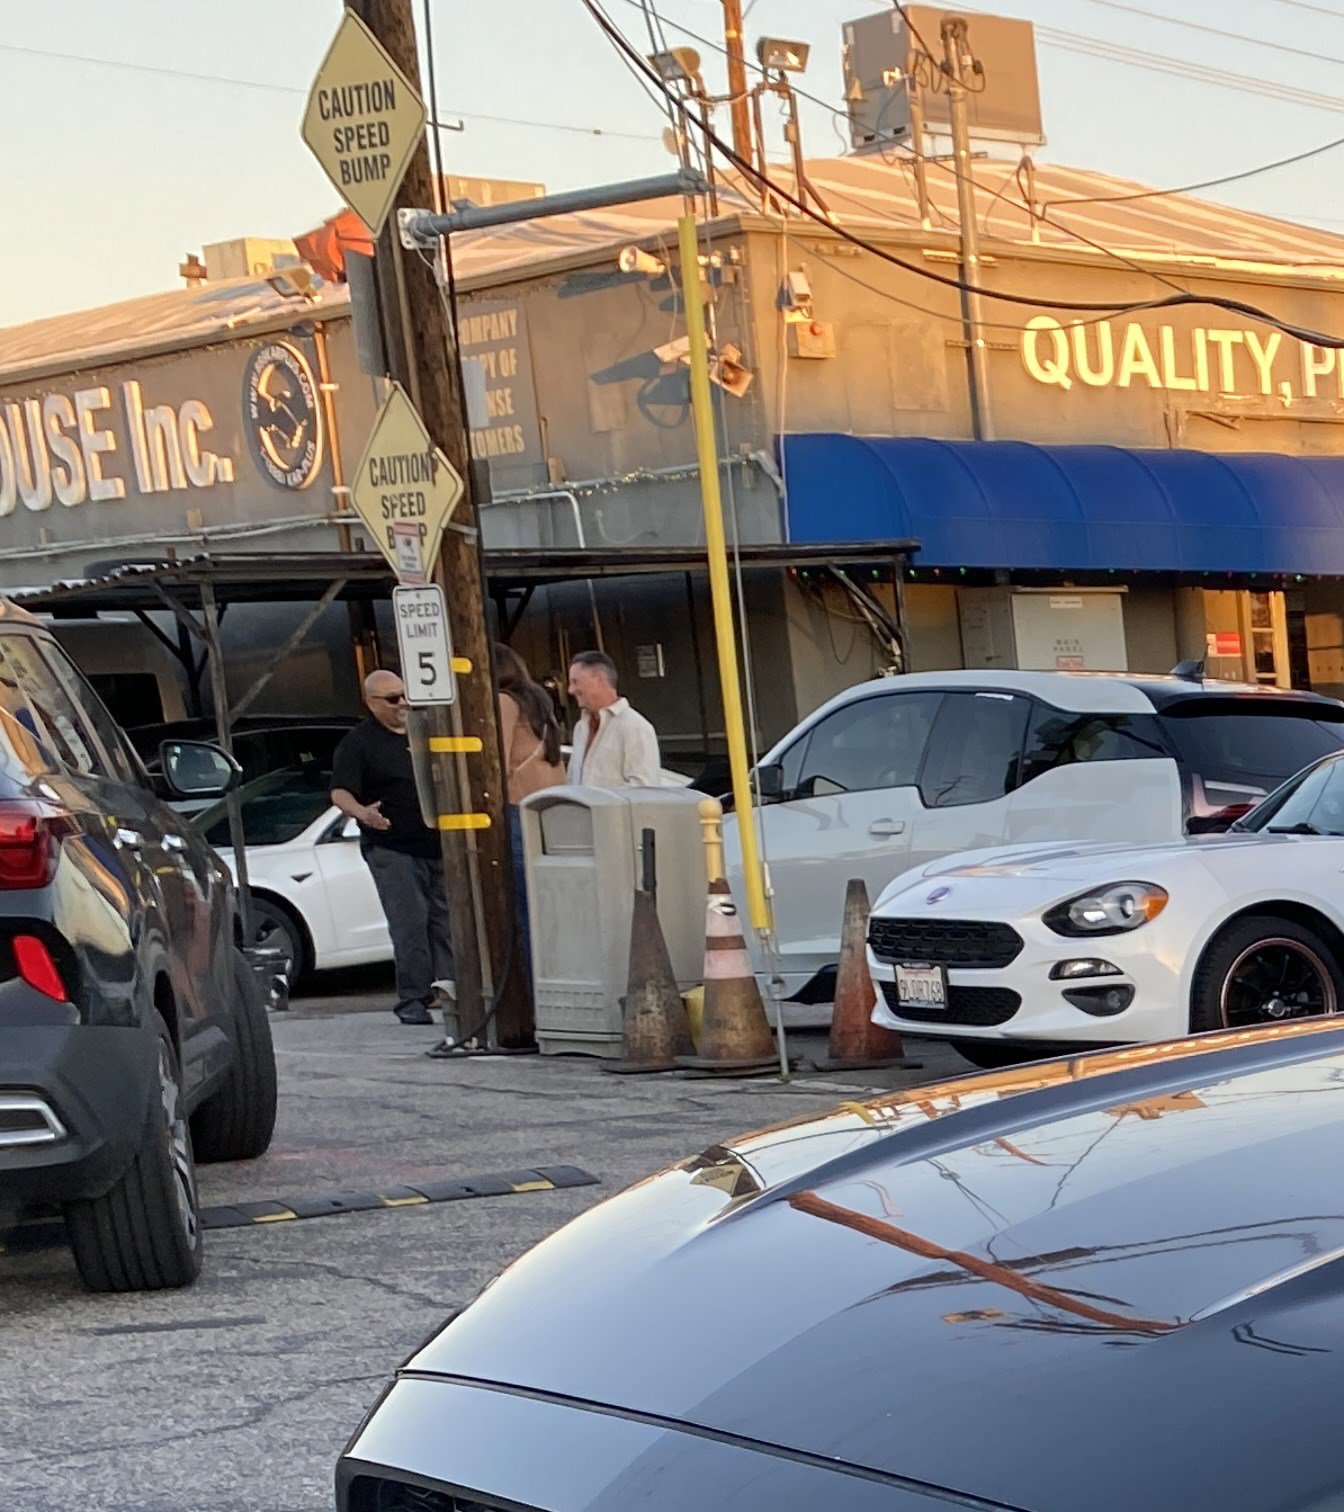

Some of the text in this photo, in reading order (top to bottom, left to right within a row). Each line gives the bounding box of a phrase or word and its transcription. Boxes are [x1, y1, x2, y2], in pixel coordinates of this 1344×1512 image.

[318, 79, 395, 120] CAUTION
[333, 121, 390, 153] SPEED
[340, 153, 391, 185] BUMP
[459, 308, 518, 346] OMPANY
[1021, 315, 1292, 407] QUALITY,
[122, 380, 235, 494] Inc.
[369, 452, 433, 487] CAUTION
[381, 491, 426, 519] SPEED
[386, 523, 428, 549] BP
[400, 602, 440, 618] SPEED
[406, 622, 438, 638] LIMIT
[418, 652, 437, 685] 5
